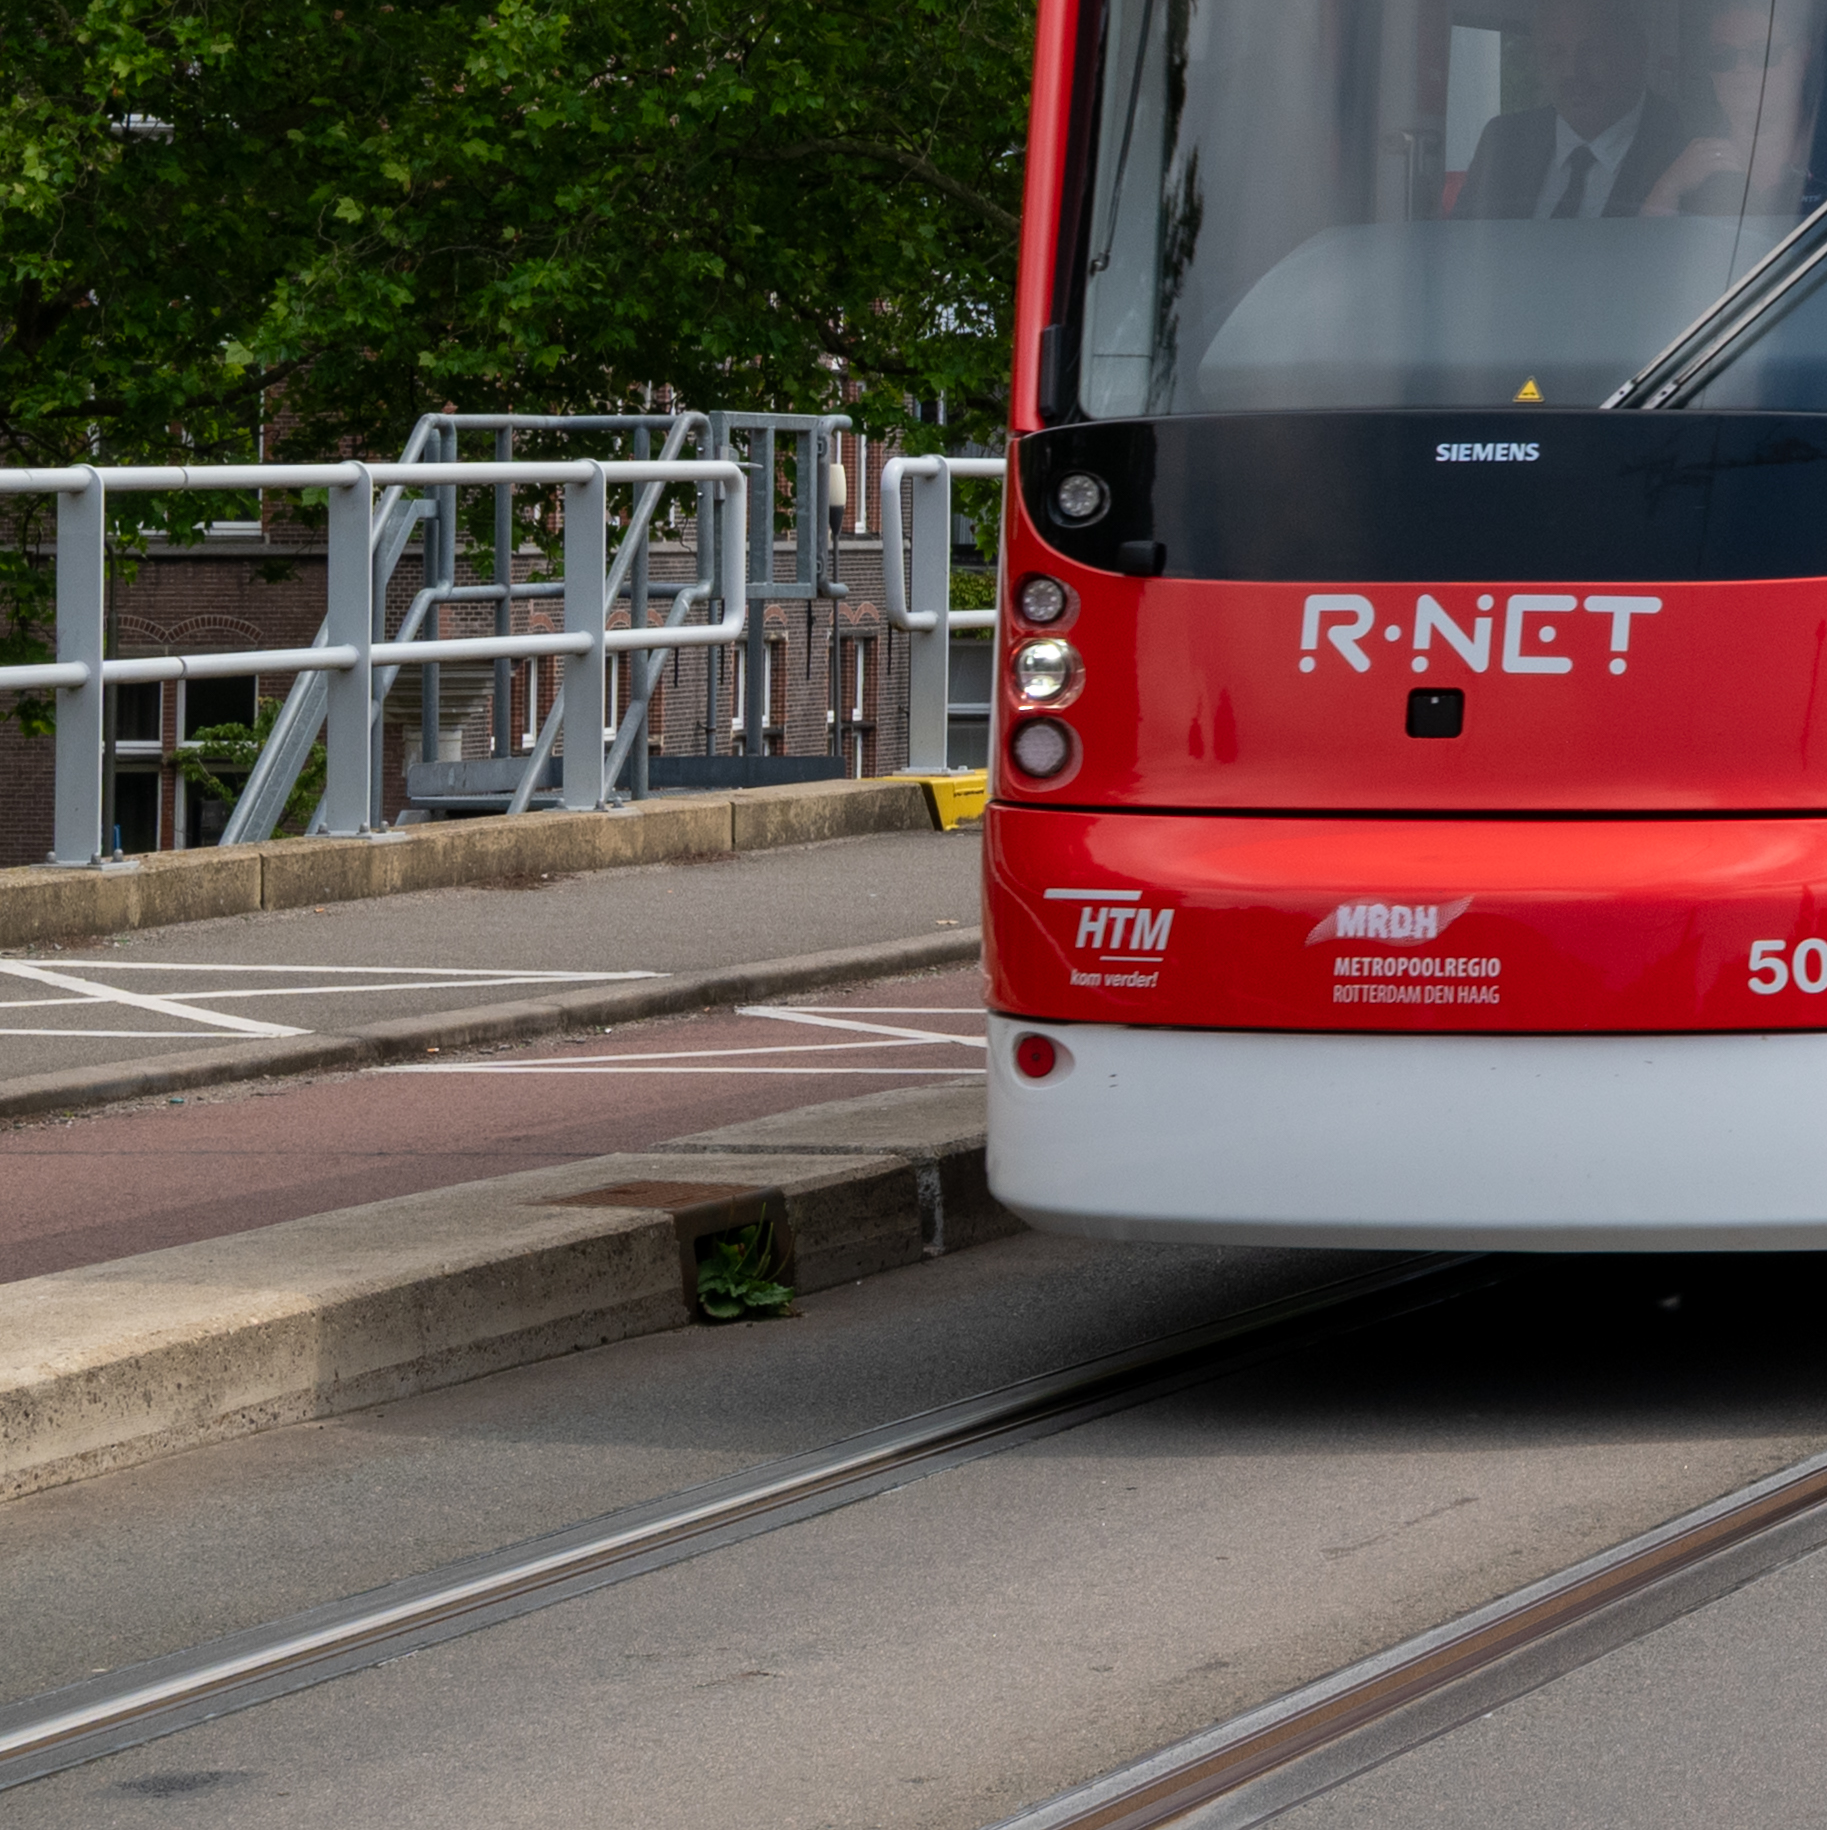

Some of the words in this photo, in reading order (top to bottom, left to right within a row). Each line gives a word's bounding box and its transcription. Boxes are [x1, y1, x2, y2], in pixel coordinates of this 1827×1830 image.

[1435, 442, 1540, 462] SIEMENS
[1075, 906, 1176, 951] HTM
[1336, 903, 1439, 939] MRDH
[1333, 956, 1502, 978] METROPOOLREGIO
[1070, 969, 1102, 986] kom
[1103, 971, 1160, 988] verder!
[1332, 984, 1422, 1004] ROTTERDAM
[1423, 985, 1455, 1005] DEN
[1456, 985, 1500, 1005] HAAG
